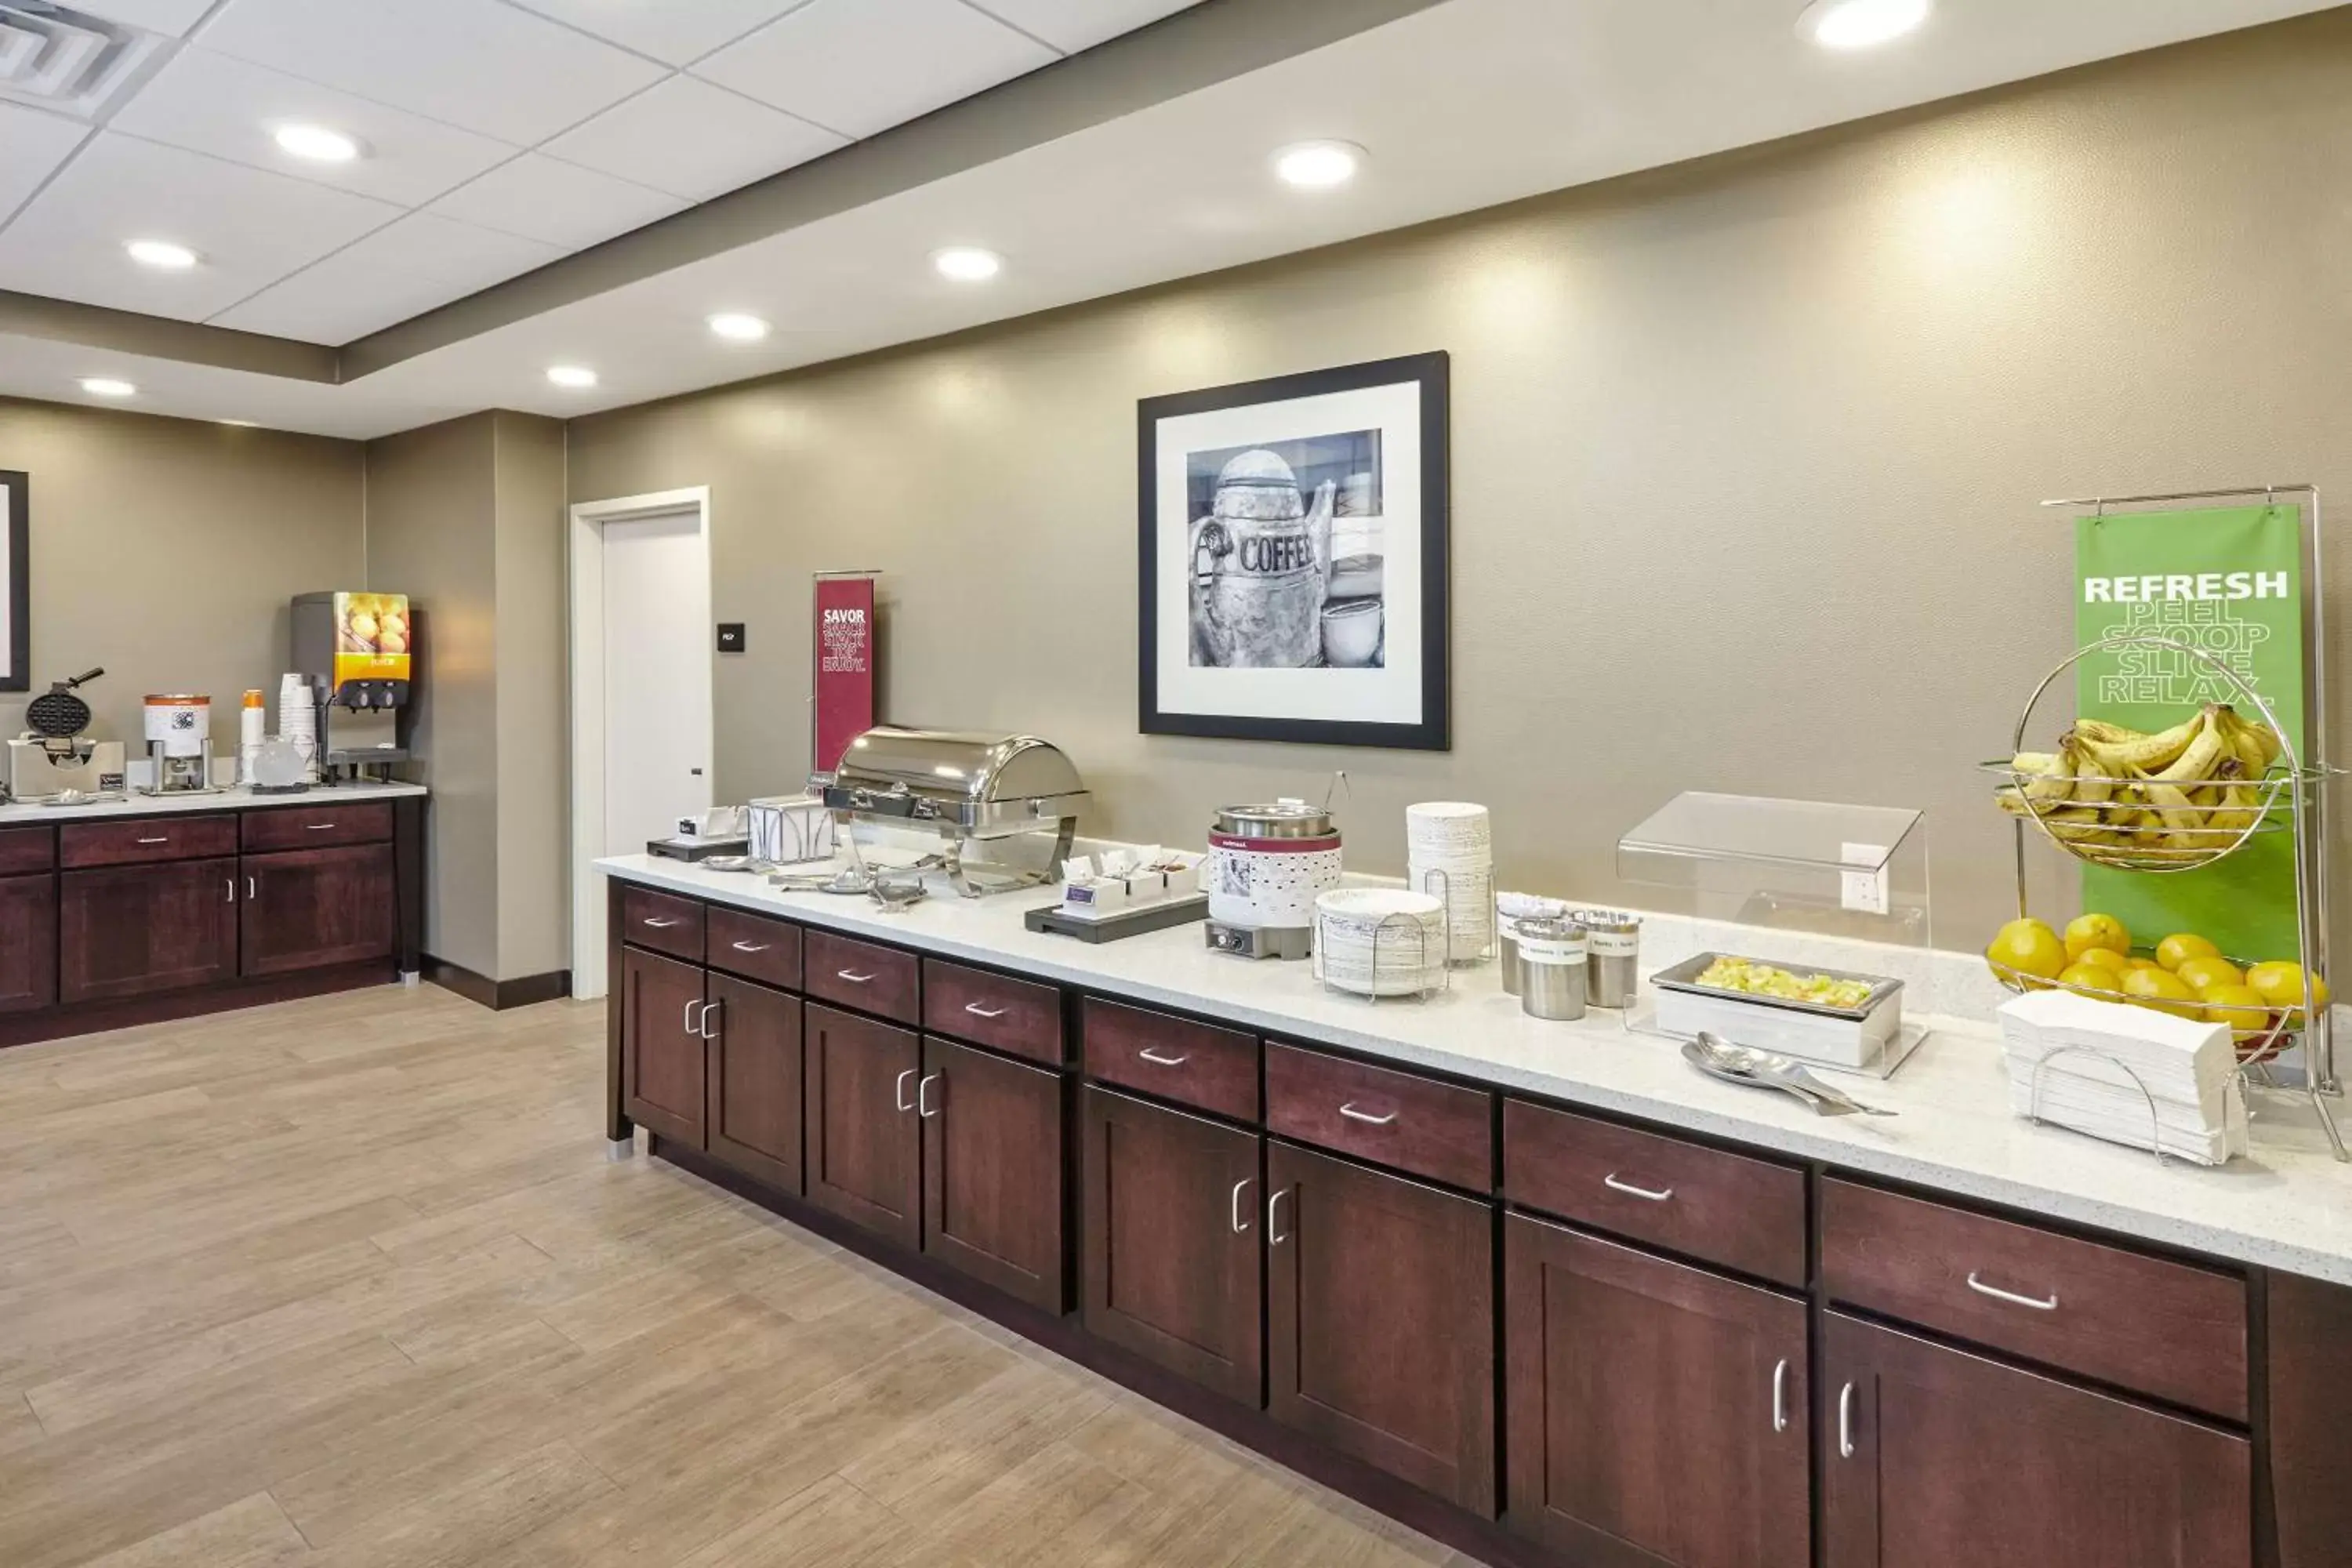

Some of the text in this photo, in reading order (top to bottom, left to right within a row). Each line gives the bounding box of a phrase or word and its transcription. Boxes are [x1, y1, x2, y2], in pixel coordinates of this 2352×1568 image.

[2085, 572, 2288, 603] REFRESH
[824, 609, 865, 624] SAVOR
[2126, 598, 2243, 626] PEEL
[2102, 623, 2270, 653] SCOOP
[2118, 650, 2252, 679] SLICE
[2099, 675, 2275, 706] RELAX.
